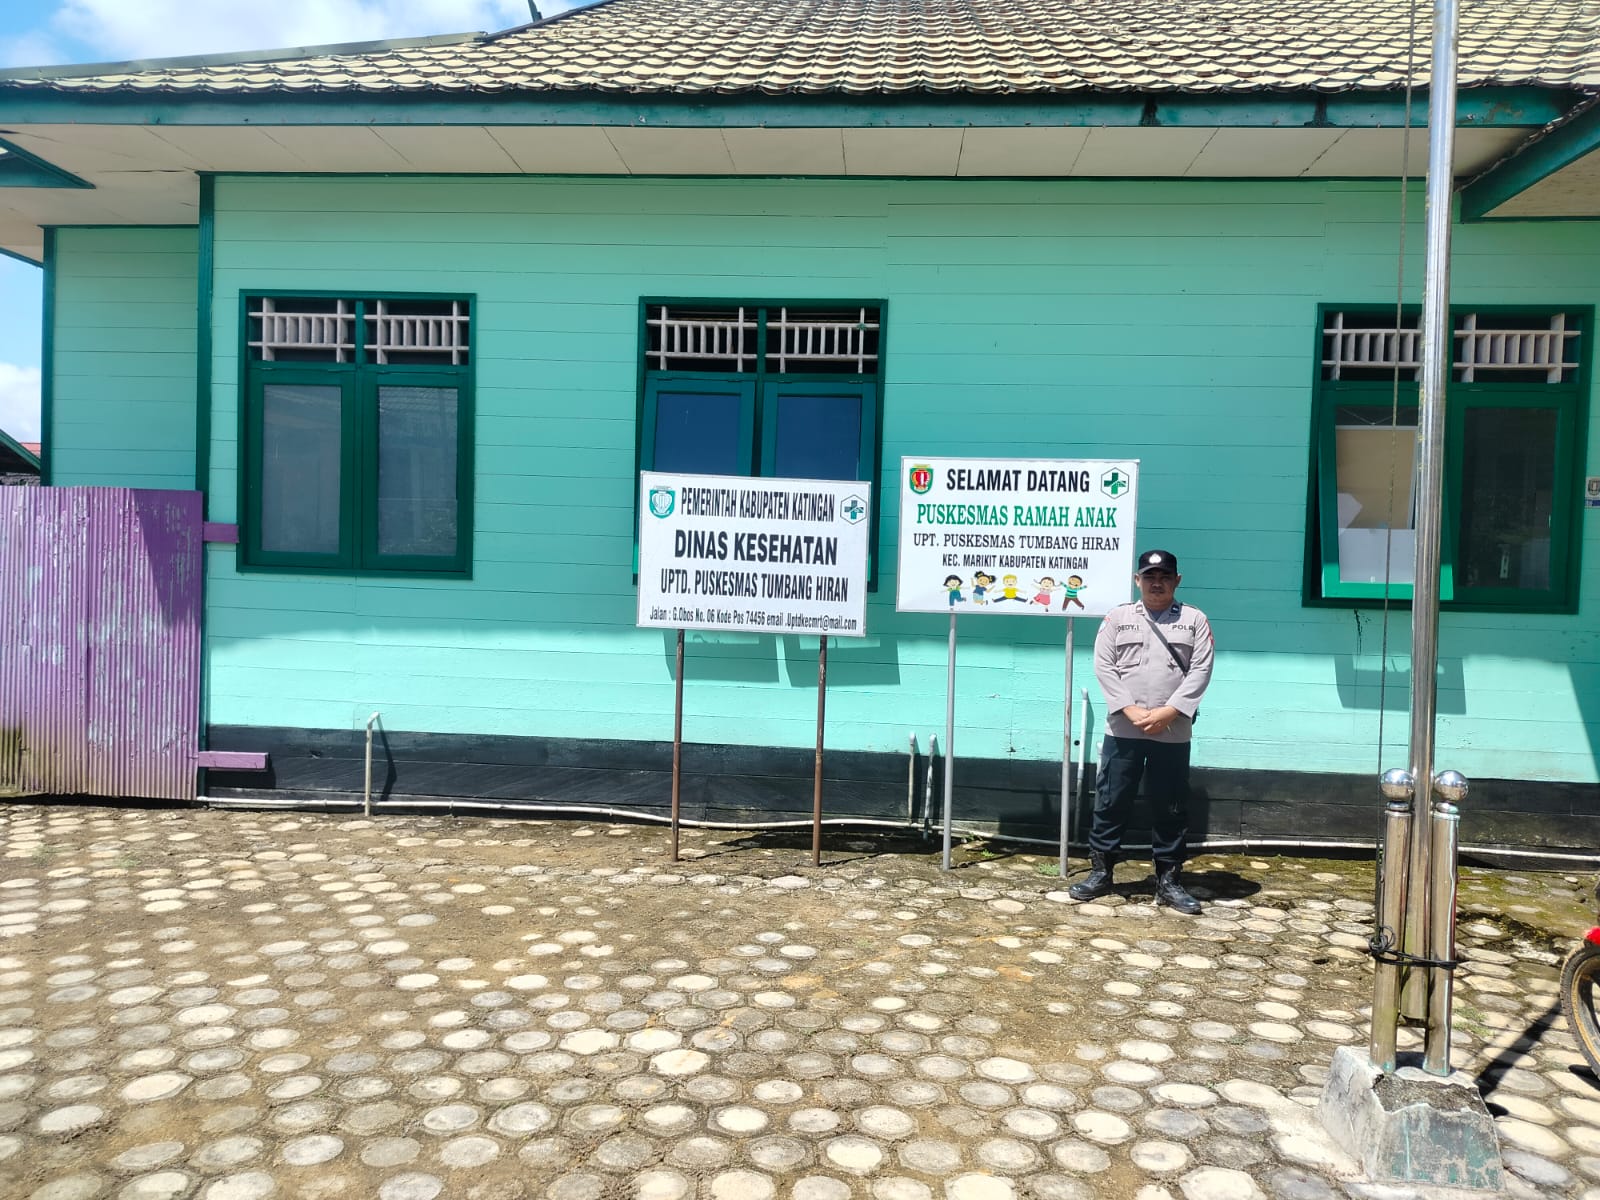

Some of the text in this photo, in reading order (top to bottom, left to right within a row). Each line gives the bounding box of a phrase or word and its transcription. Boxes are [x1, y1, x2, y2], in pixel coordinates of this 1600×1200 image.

[947, 468, 1090, 492] SELAMAT DATANG
[681, 487, 835, 522] PEMERINTAH KABUPATEN KATINGAN
[916, 503, 1117, 528] PUSKESMAS RAMAH ANAK
[675, 529, 838, 566] DINAS KESEHATAN
[913, 533, 1120, 550] UPT. PUSKESMAS TUMBANG HIRAN
[942, 554, 1088, 569] KEC. MARIKIT KABUPATEN KATINGAN
[661, 568, 848, 602] UPTD. PUSKESMAS TUMBANG HIRAN
[650, 606, 667, 620] Jalan
[673, 607, 693, 622] G.Obos
[695, 608, 705, 622] No.
[707, 609, 715, 623] 06
[717, 609, 731, 623] Kode
[734, 610, 744, 624] Pos
[746, 611, 765, 625] 74456
[767, 612, 783, 626] email
